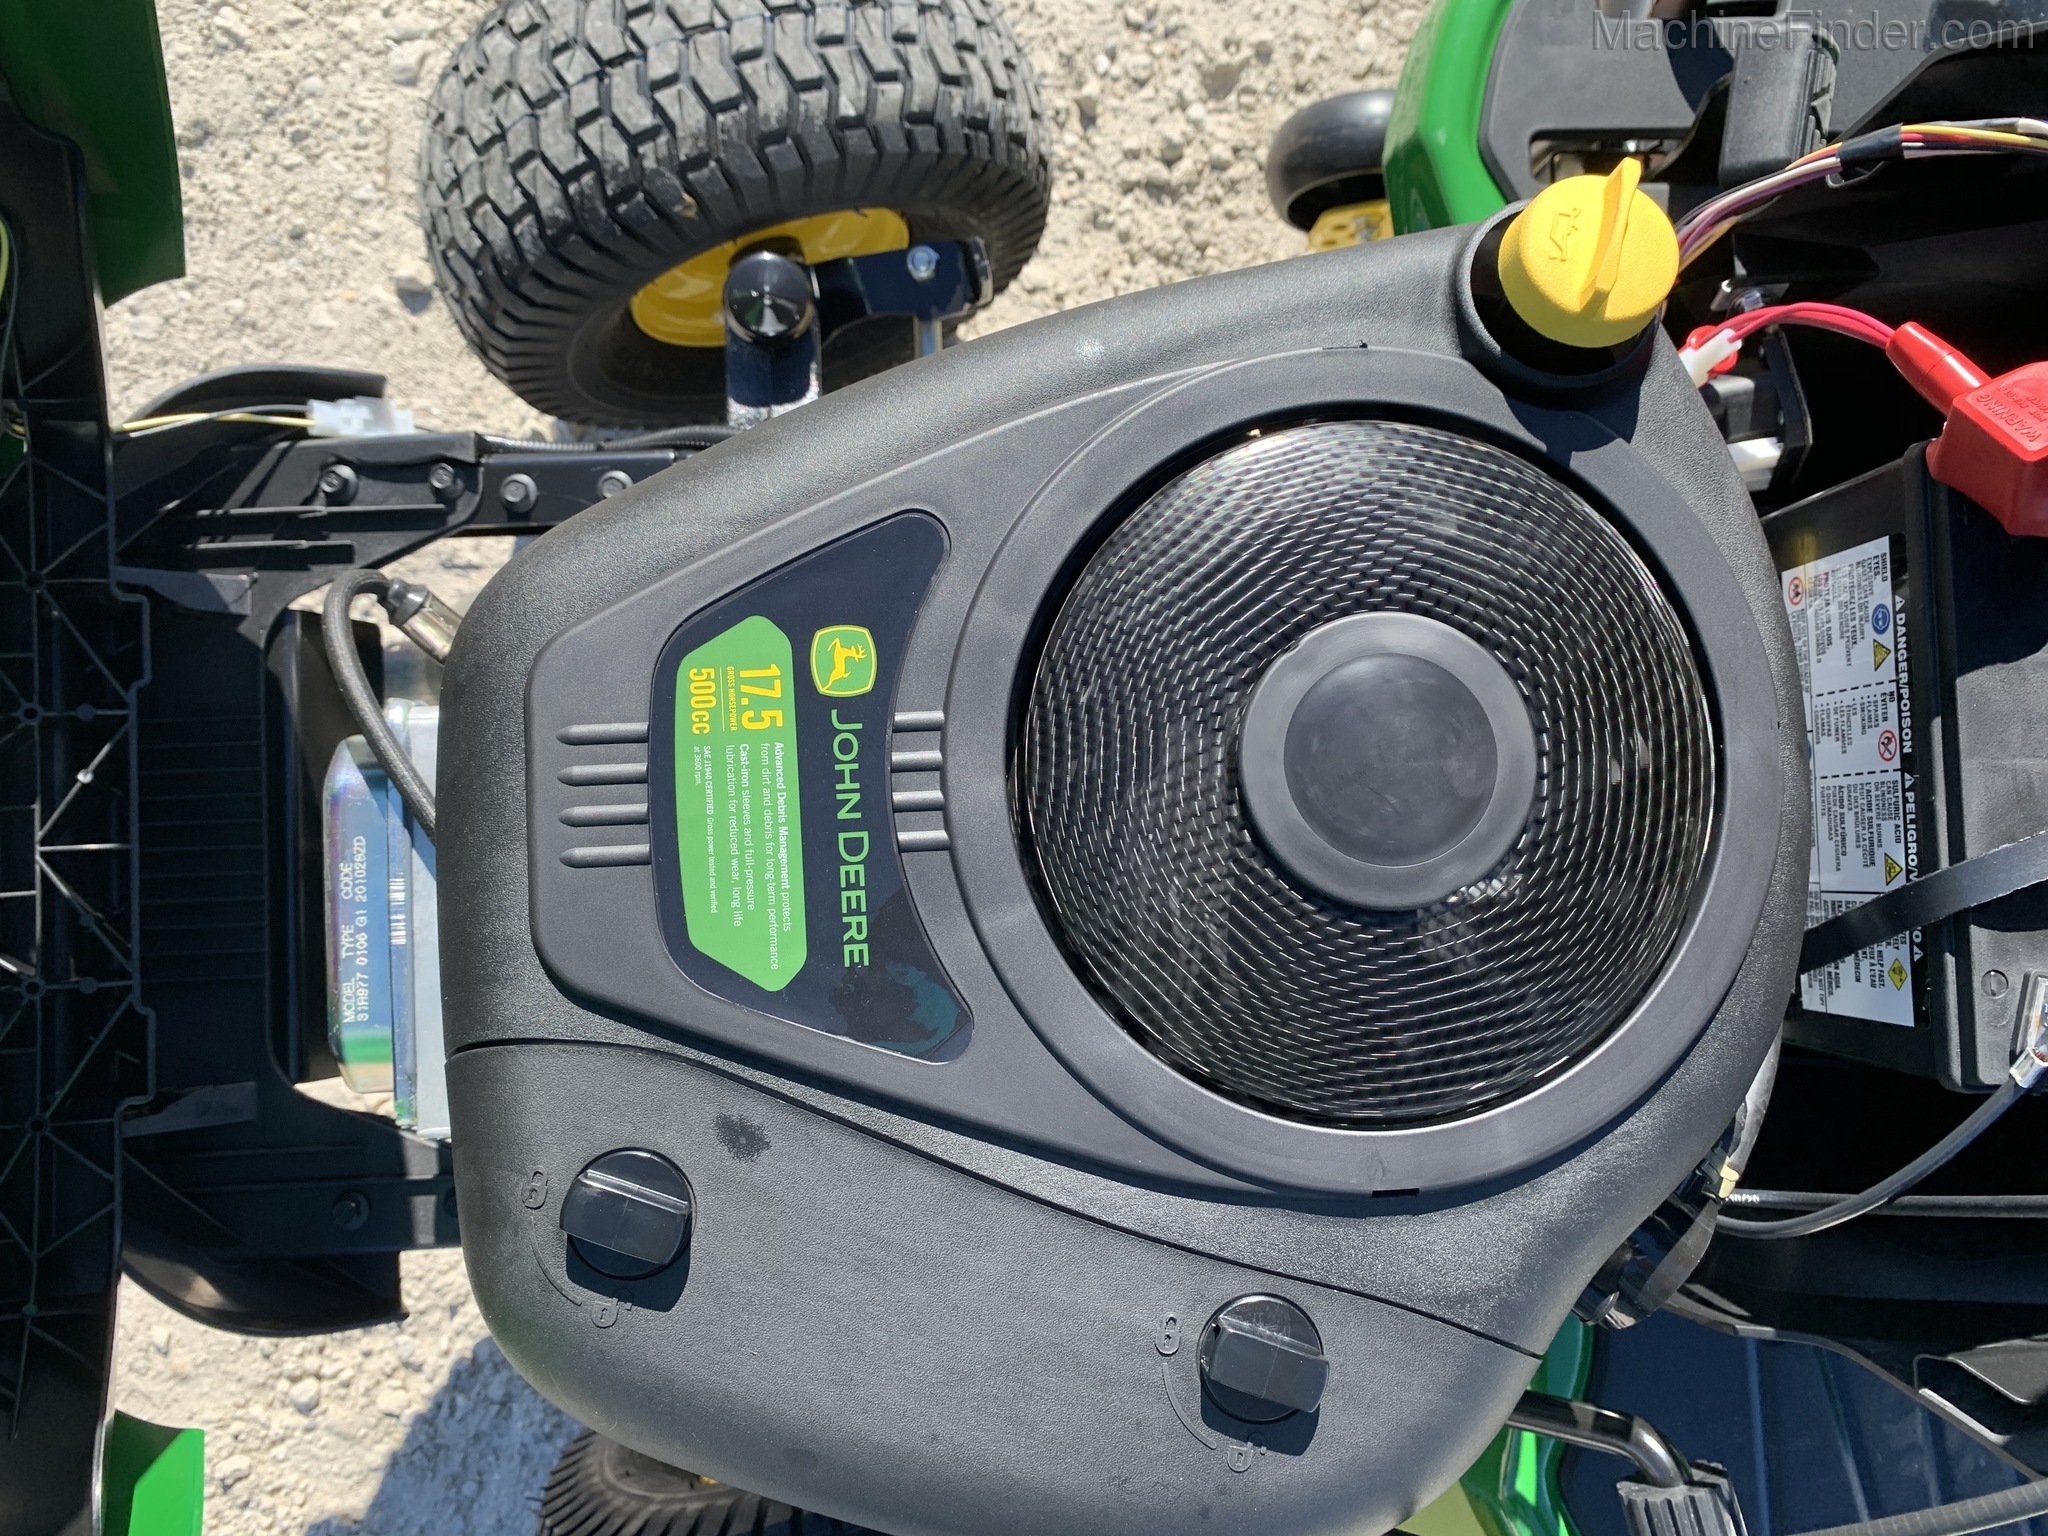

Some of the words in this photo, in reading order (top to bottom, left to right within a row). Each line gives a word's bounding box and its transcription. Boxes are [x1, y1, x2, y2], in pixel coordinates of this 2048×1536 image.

[1976, 394, 2042, 442] WARNING
[727, 666, 736, 687] GROSS
[1896, 613, 1912, 754] DANGER/POISON
[689, 668, 717, 734] 500cc
[728, 689, 737, 731] HORSEPOWER
[740, 664, 783, 730] 17.5
[1880, 691, 1888, 722] ÉVITER
[1888, 690, 1895, 703] NO
[694, 754, 702, 770] 3600
[703, 746, 711, 758] SAE
[739, 744, 750, 787] Cast-iron
[760, 743, 770, 764] from
[774, 742, 787, 789] Advanced
[831, 709, 863, 819] JOHN
[694, 772, 702, 785] rpm.
[704, 760, 712, 779] J1940
[725, 745, 739, 796] lubrication
[762, 769, 772, 785] dirt
[705, 781, 714, 814] CERTIFIED
[763, 788, 773, 806] and
[1837, 784, 1845, 809] ÁCIDO
[1865, 782, 1873, 813] L'ACIDE
[1873, 781, 1879, 792] OR
[1891, 779, 1900, 820] SULFURIC
[728, 800, 739, 812] for
[742, 790, 753, 825] sleeves
[777, 792, 788, 823] Debris
[706, 818, 715, 835] Gross
[729, 816, 741, 855] reduced
[744, 828, 754, 846] and
[764, 810, 775, 839] debris
[1839, 811, 1848, 856] SULFÚRICO
[1861, 833, 1866, 842] LA
[1893, 823, 1901, 843] ACID
[707, 836, 715, 855] power
[765, 843, 775, 854] for
[1866, 815, 1875, 866] SULFURIQUE
[708, 856, 717, 875] tested
[730, 858, 741, 883] wear,
[777, 826, 791, 889] Management
[340, 863, 353, 899] CODE
[709, 877, 717, 889] and
[744, 849, 756, 910] full-pressure
[765, 859, 777, 905] long-term
[709, 890, 718, 913] verified
[731, 887, 742, 908] long
[780, 892, 792, 931] protects
[838, 831, 869, 967] DEERE
[733, 911, 744, 926] life
[341, 925, 354, 958] TYPE
[767, 909, 780, 970] performance
[1876, 949, 1884, 968] HELP
[1877, 969, 1885, 989] FAST.
[343, 978, 355, 1022] MODEL
